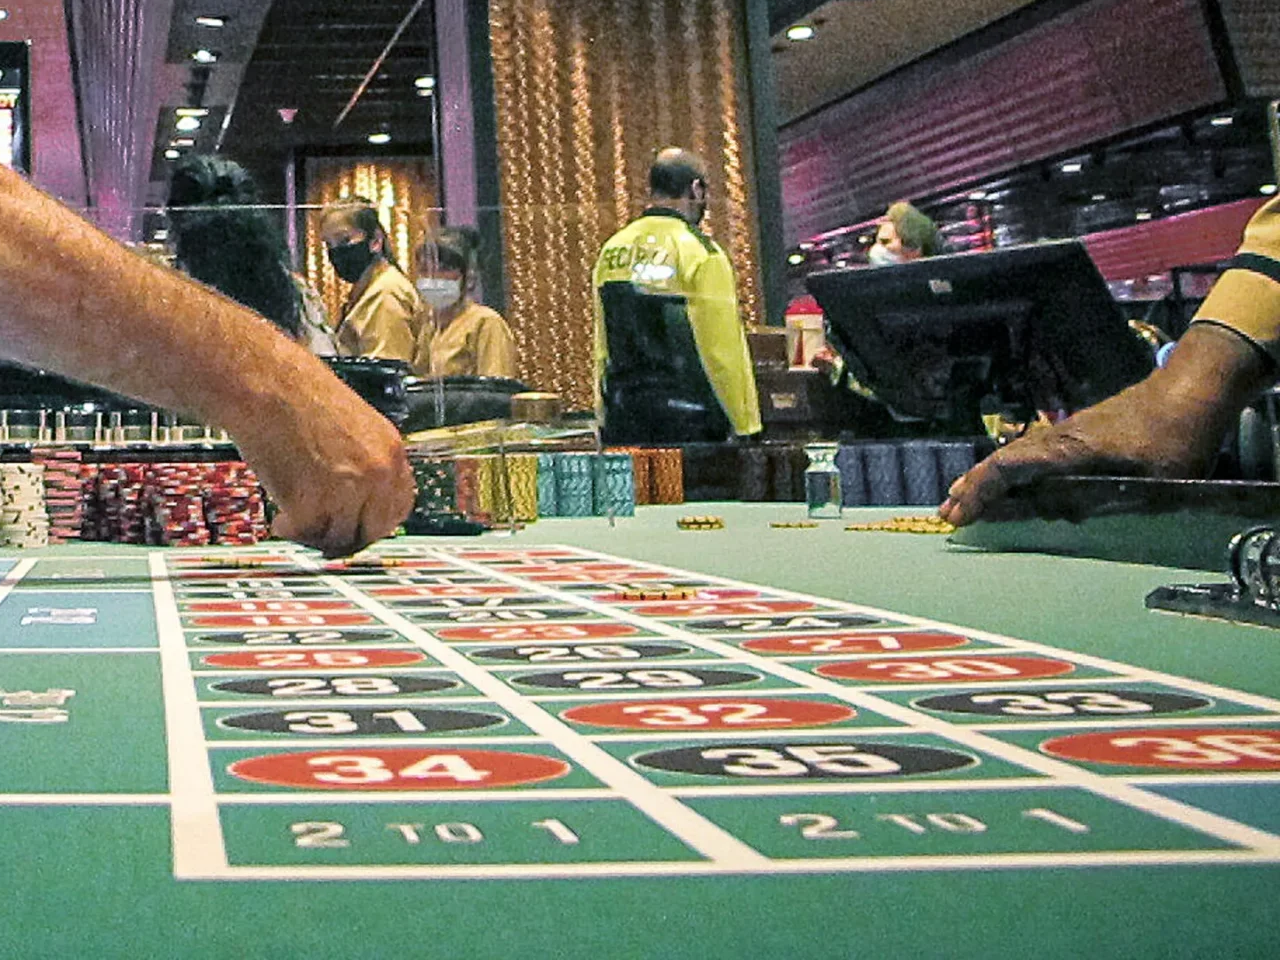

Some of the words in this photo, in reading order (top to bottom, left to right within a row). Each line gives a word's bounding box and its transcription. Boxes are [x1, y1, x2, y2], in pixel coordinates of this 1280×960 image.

[242, 631, 347, 645] 22
[788, 635, 902, 652] 27
[256, 651, 371, 667] 25
[867, 659, 1021, 678] 30
[268, 675, 401, 697] 28
[562, 669, 705, 690] 29
[621, 703, 794, 726] 32
[970, 691, 1154, 715] 33
[283, 709, 428, 733] 31
[700, 744, 901, 776] 35
[1110, 734, 1280, 764] 36
[306, 753, 491, 785] 34
[290, 820, 351, 848] 2
[385, 821, 484, 845] TO
[532, 818, 581, 845] 1
[779, 813, 860, 840] 2
[875, 812, 988, 834] TO
[1023, 808, 1091, 834] 1
